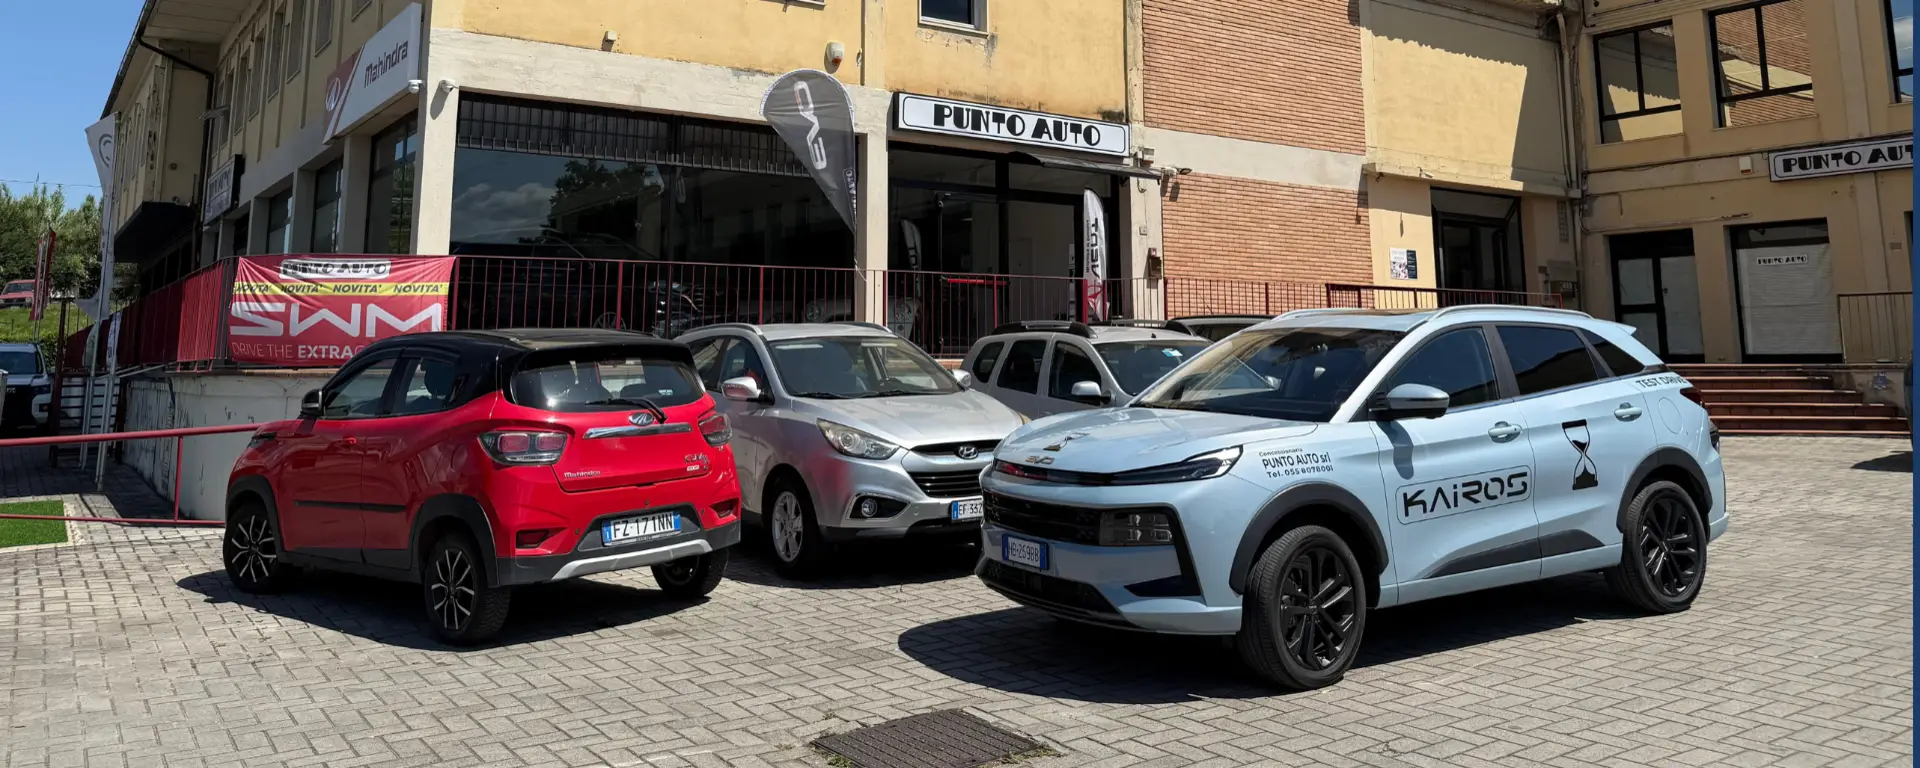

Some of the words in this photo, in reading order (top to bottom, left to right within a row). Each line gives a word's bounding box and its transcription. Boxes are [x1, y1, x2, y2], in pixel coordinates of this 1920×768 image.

[364, 40, 408, 88] Mahindra
[933, 103, 1026, 136] PUNTO
[1031, 118, 1101, 146] AUTO
[1782, 150, 1862, 173] PUNTO
[1757, 257, 1784, 265] PUNTO
[1785, 255, 1807, 263] AUTO
[338, 263, 388, 275] AUTO
[230, 301, 442, 338] SWM
[232, 342, 265, 357] DRIVE
[267, 344, 294, 359] THE
[1635, 377, 1662, 388] TEST
[1262, 455, 1295, 470] PUNTO
[1296, 452, 1319, 465] AUTO
[1320, 452, 1331, 463] srl
[563, 470, 601, 480] Mahindra
[1266, 469, 1284, 479] Tel.
[1284, 467, 1300, 476] 055
